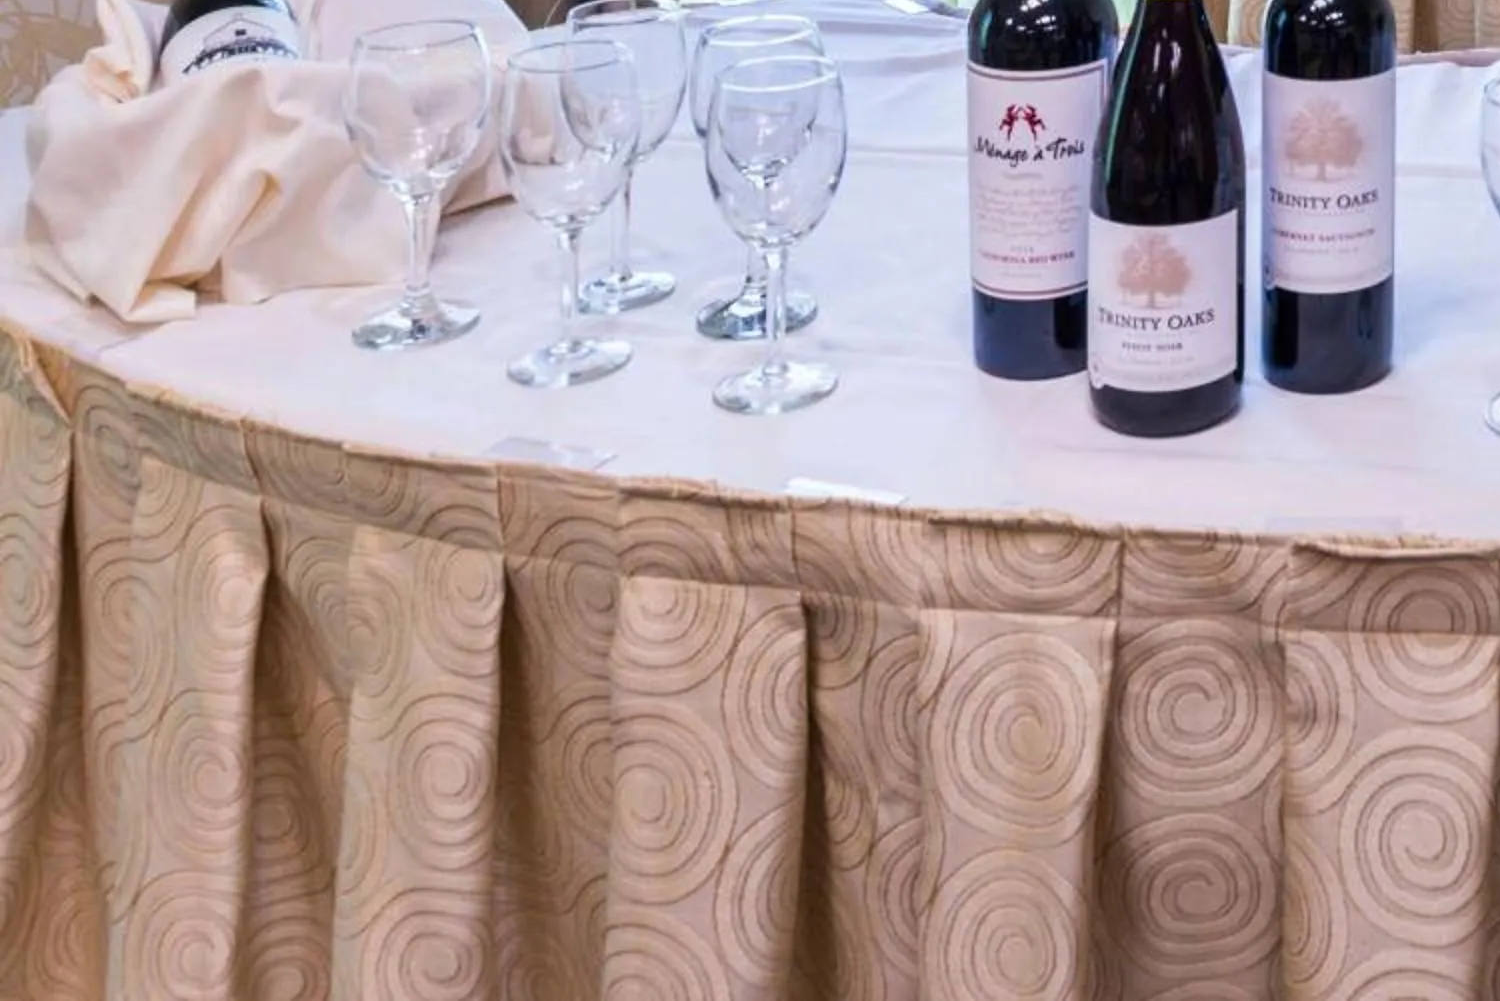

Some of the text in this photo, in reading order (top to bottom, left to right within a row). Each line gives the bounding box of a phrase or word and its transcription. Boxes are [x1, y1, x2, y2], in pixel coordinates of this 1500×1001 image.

[1045, 136, 1085, 160] Trois
[1268, 186, 1379, 210] TRINITY OAKS
[1098, 307, 1216, 331] TRINITY OAKS
